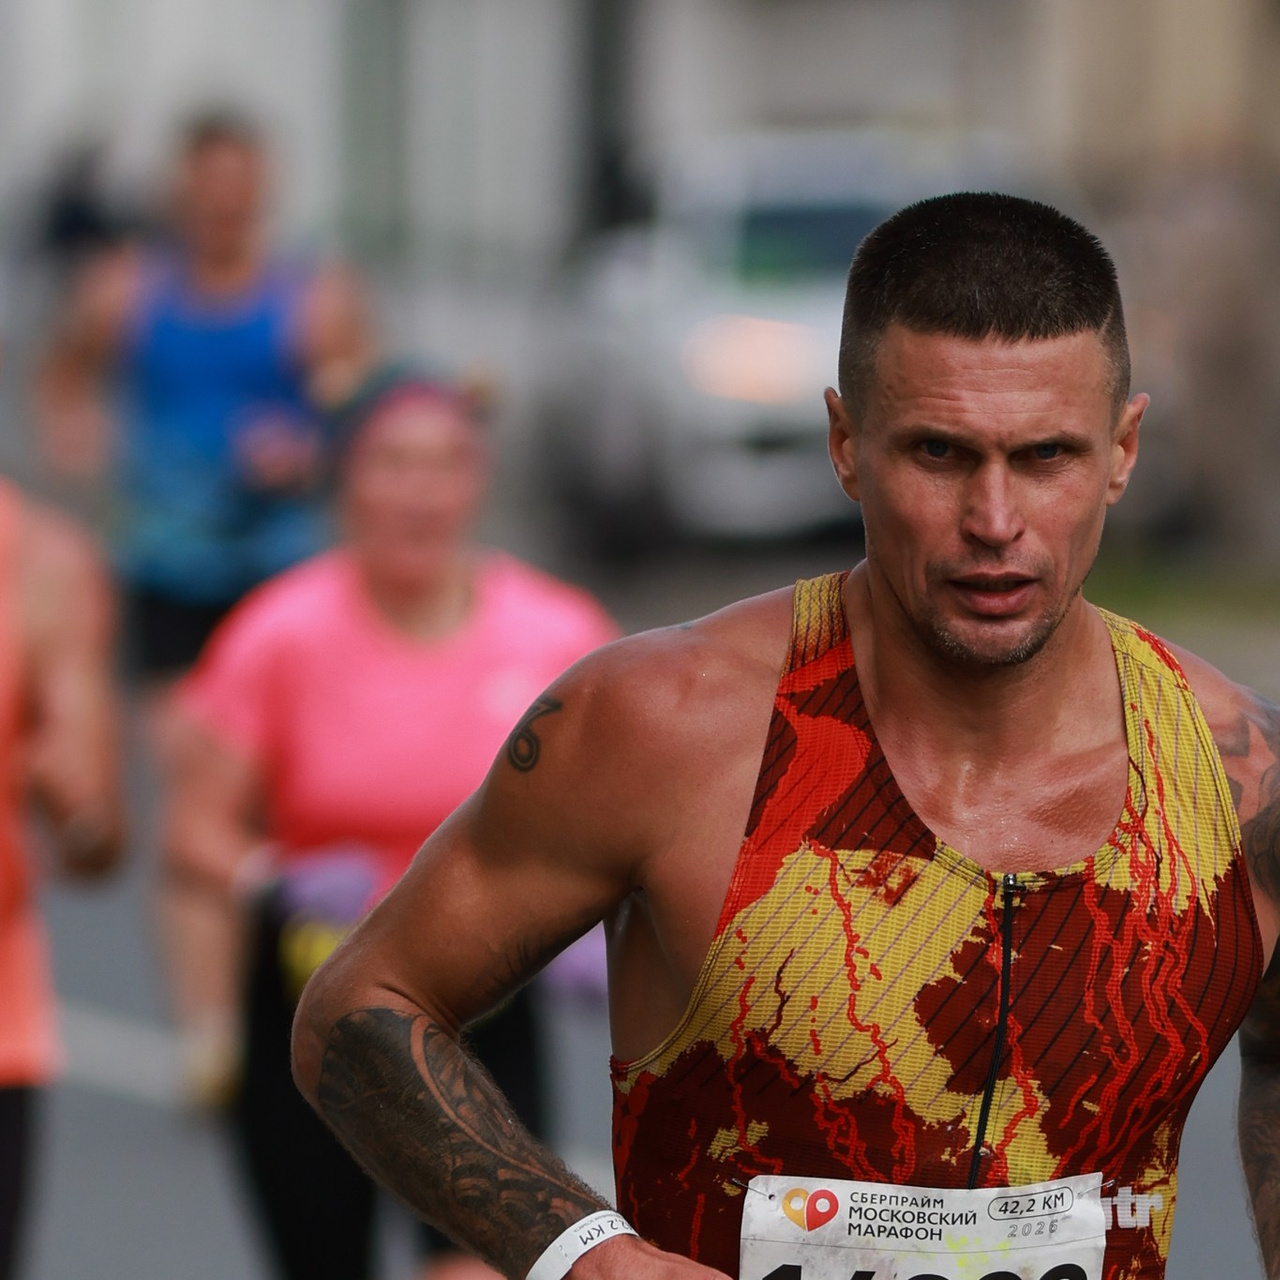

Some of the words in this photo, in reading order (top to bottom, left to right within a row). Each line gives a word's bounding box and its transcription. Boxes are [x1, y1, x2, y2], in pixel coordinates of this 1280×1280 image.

[850, 1191, 944, 1208] СБЕРПРАЙМ
[998, 1196, 1035, 1215] 42,2
[848, 1206, 977, 1226] МОСКОВСКИЙ
[847, 1222, 943, 1241] МАРАФОН
[1007, 1219, 1059, 1239] 2026
